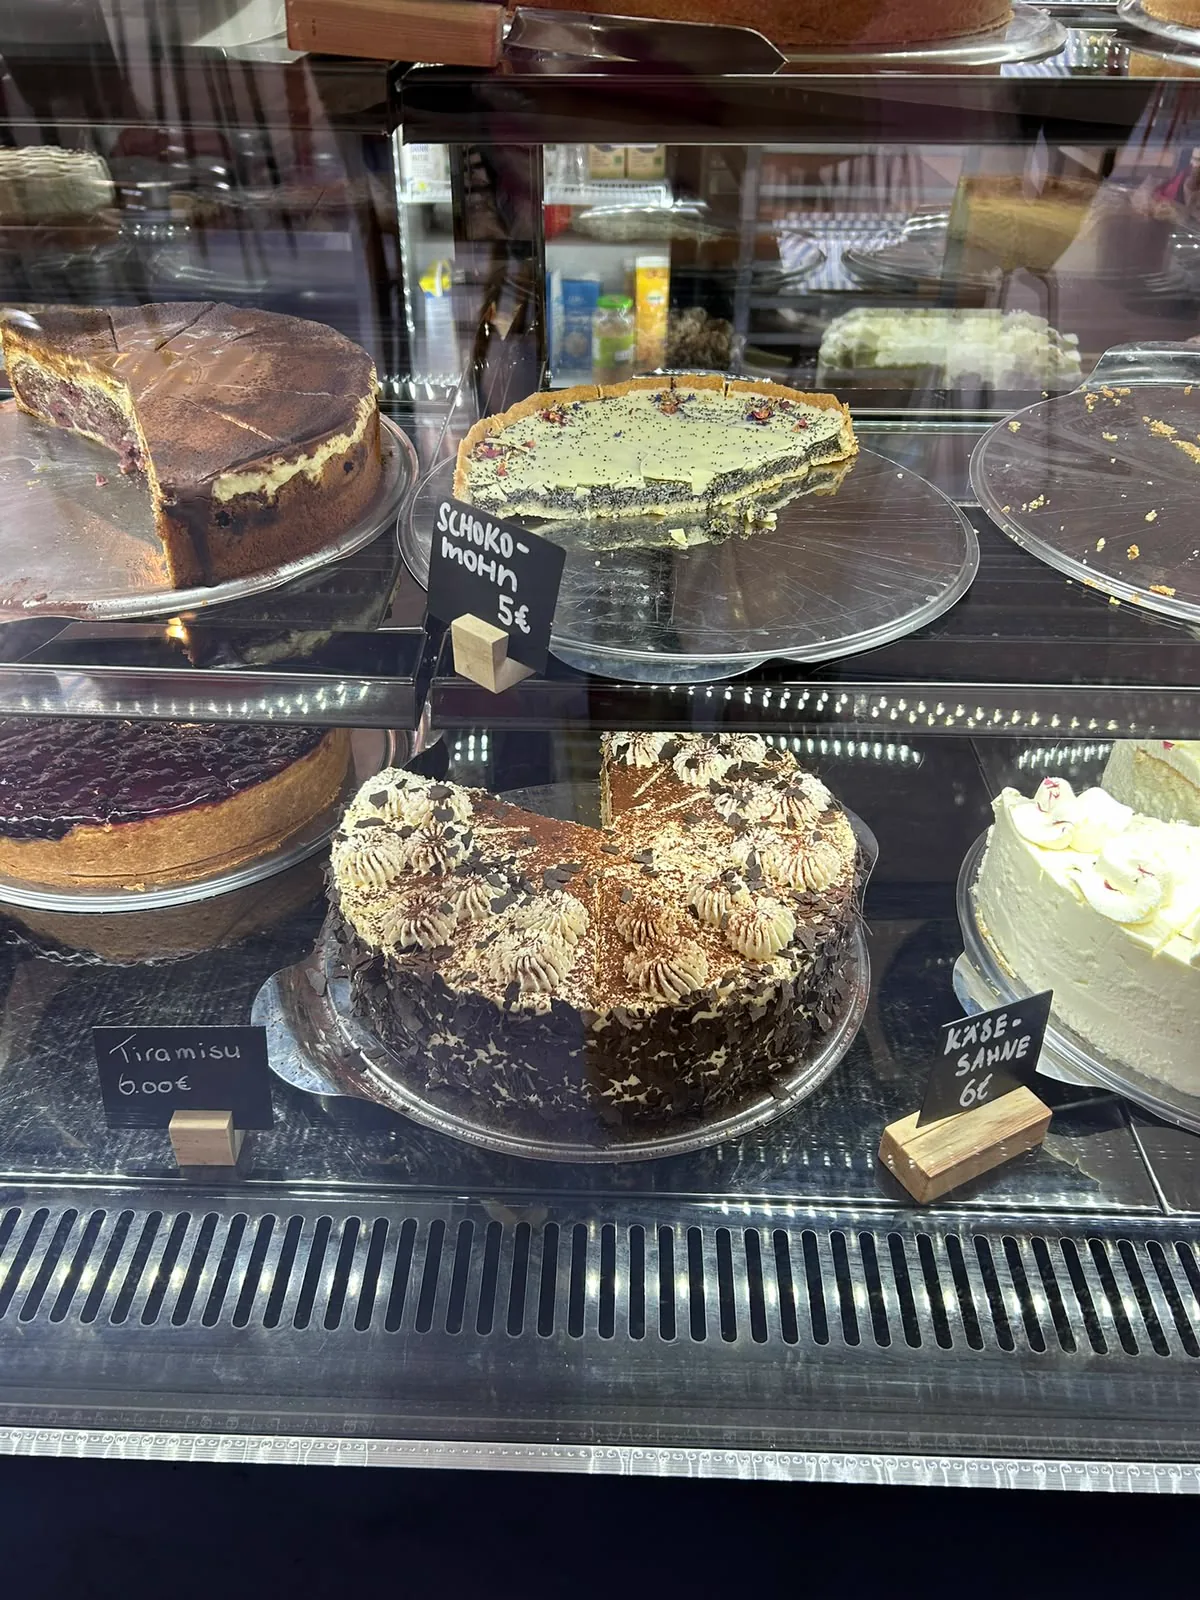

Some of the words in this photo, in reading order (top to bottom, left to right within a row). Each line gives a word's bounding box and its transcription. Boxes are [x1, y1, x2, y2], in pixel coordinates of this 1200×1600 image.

[437, 502, 530, 558] SCHOKO-
[497, 594, 531, 634] 5€
[109, 1033, 241, 1063] Tiramisu
[955, 1035, 1031, 1077] SAHNE
[118, 1073, 192, 1096] 6.00€
[959, 1073, 993, 1107] 6€
